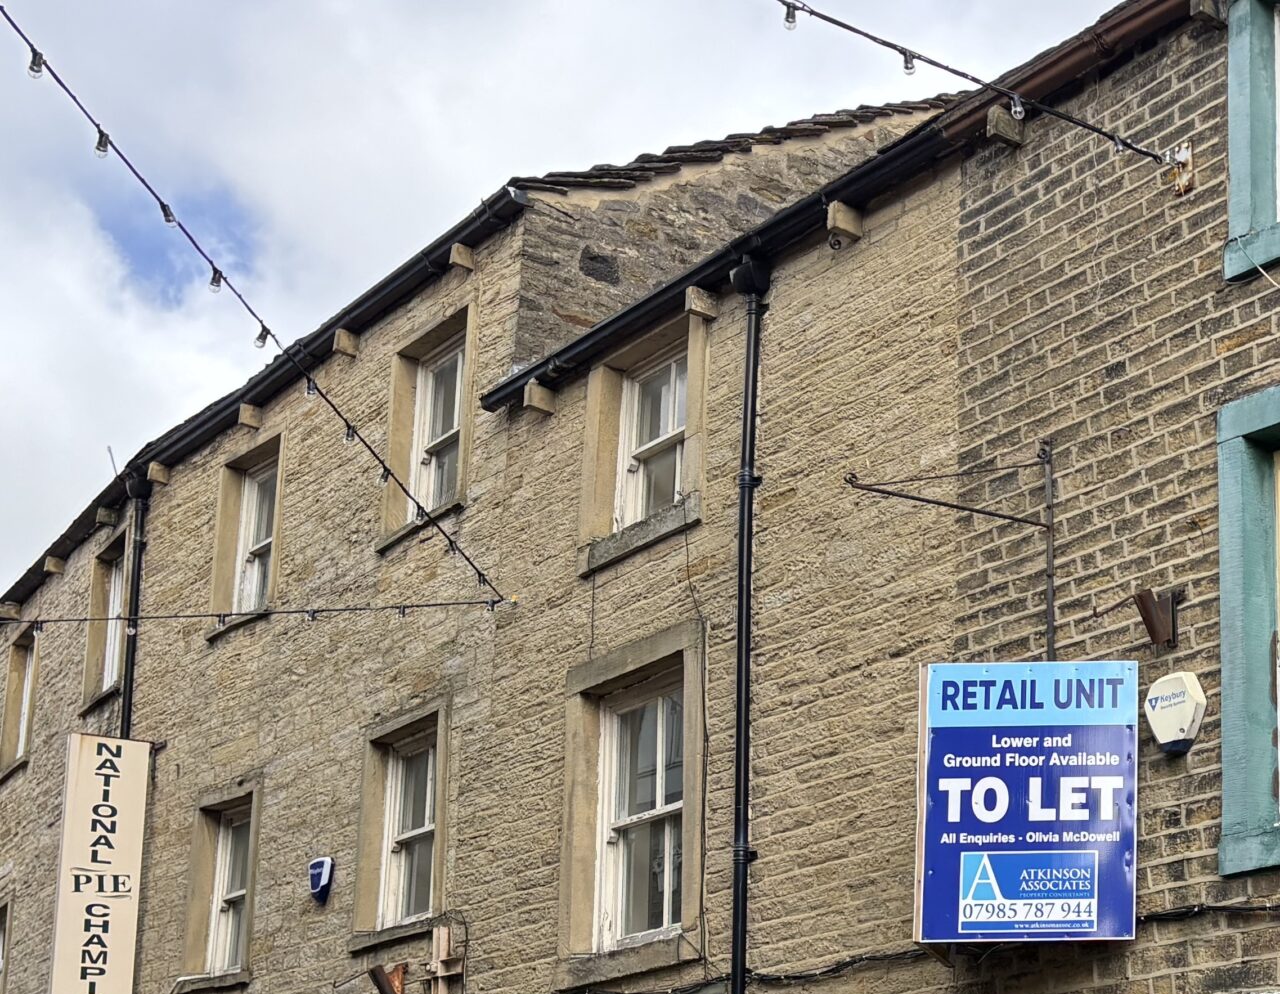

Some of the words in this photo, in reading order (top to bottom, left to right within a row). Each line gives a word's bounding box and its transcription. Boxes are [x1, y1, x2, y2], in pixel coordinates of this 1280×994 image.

[941, 679, 1044, 711] RETAIL
[1053, 678, 1125, 710] UNIT
[1160, 690, 1186, 703] Keybury
[991, 734, 1040, 748] Lower
[1043, 734, 1072, 747] and
[943, 753, 1001, 768] Ground
[1005, 752, 1045, 767] Floor
[1049, 752, 1120, 766] Available
[90, 742, 122, 865] NATIONAL
[938, 776, 1010, 823] TO
[1028, 775, 1124, 822] LET
[940, 832, 956, 844] All
[959, 832, 1015, 846] Enquiries
[1026, 831, 1059, 843] Olivia
[1063, 831, 1120, 842] McDowell
[1019, 868, 1091, 881] ATKINSON
[71, 873, 132, 894] PIE
[1019, 879, 1091, 891] ASSOCIATES
[962, 902, 1018, 920] 07985
[1022, 901, 1055, 919] 787
[1060, 900, 1093, 918] 944
